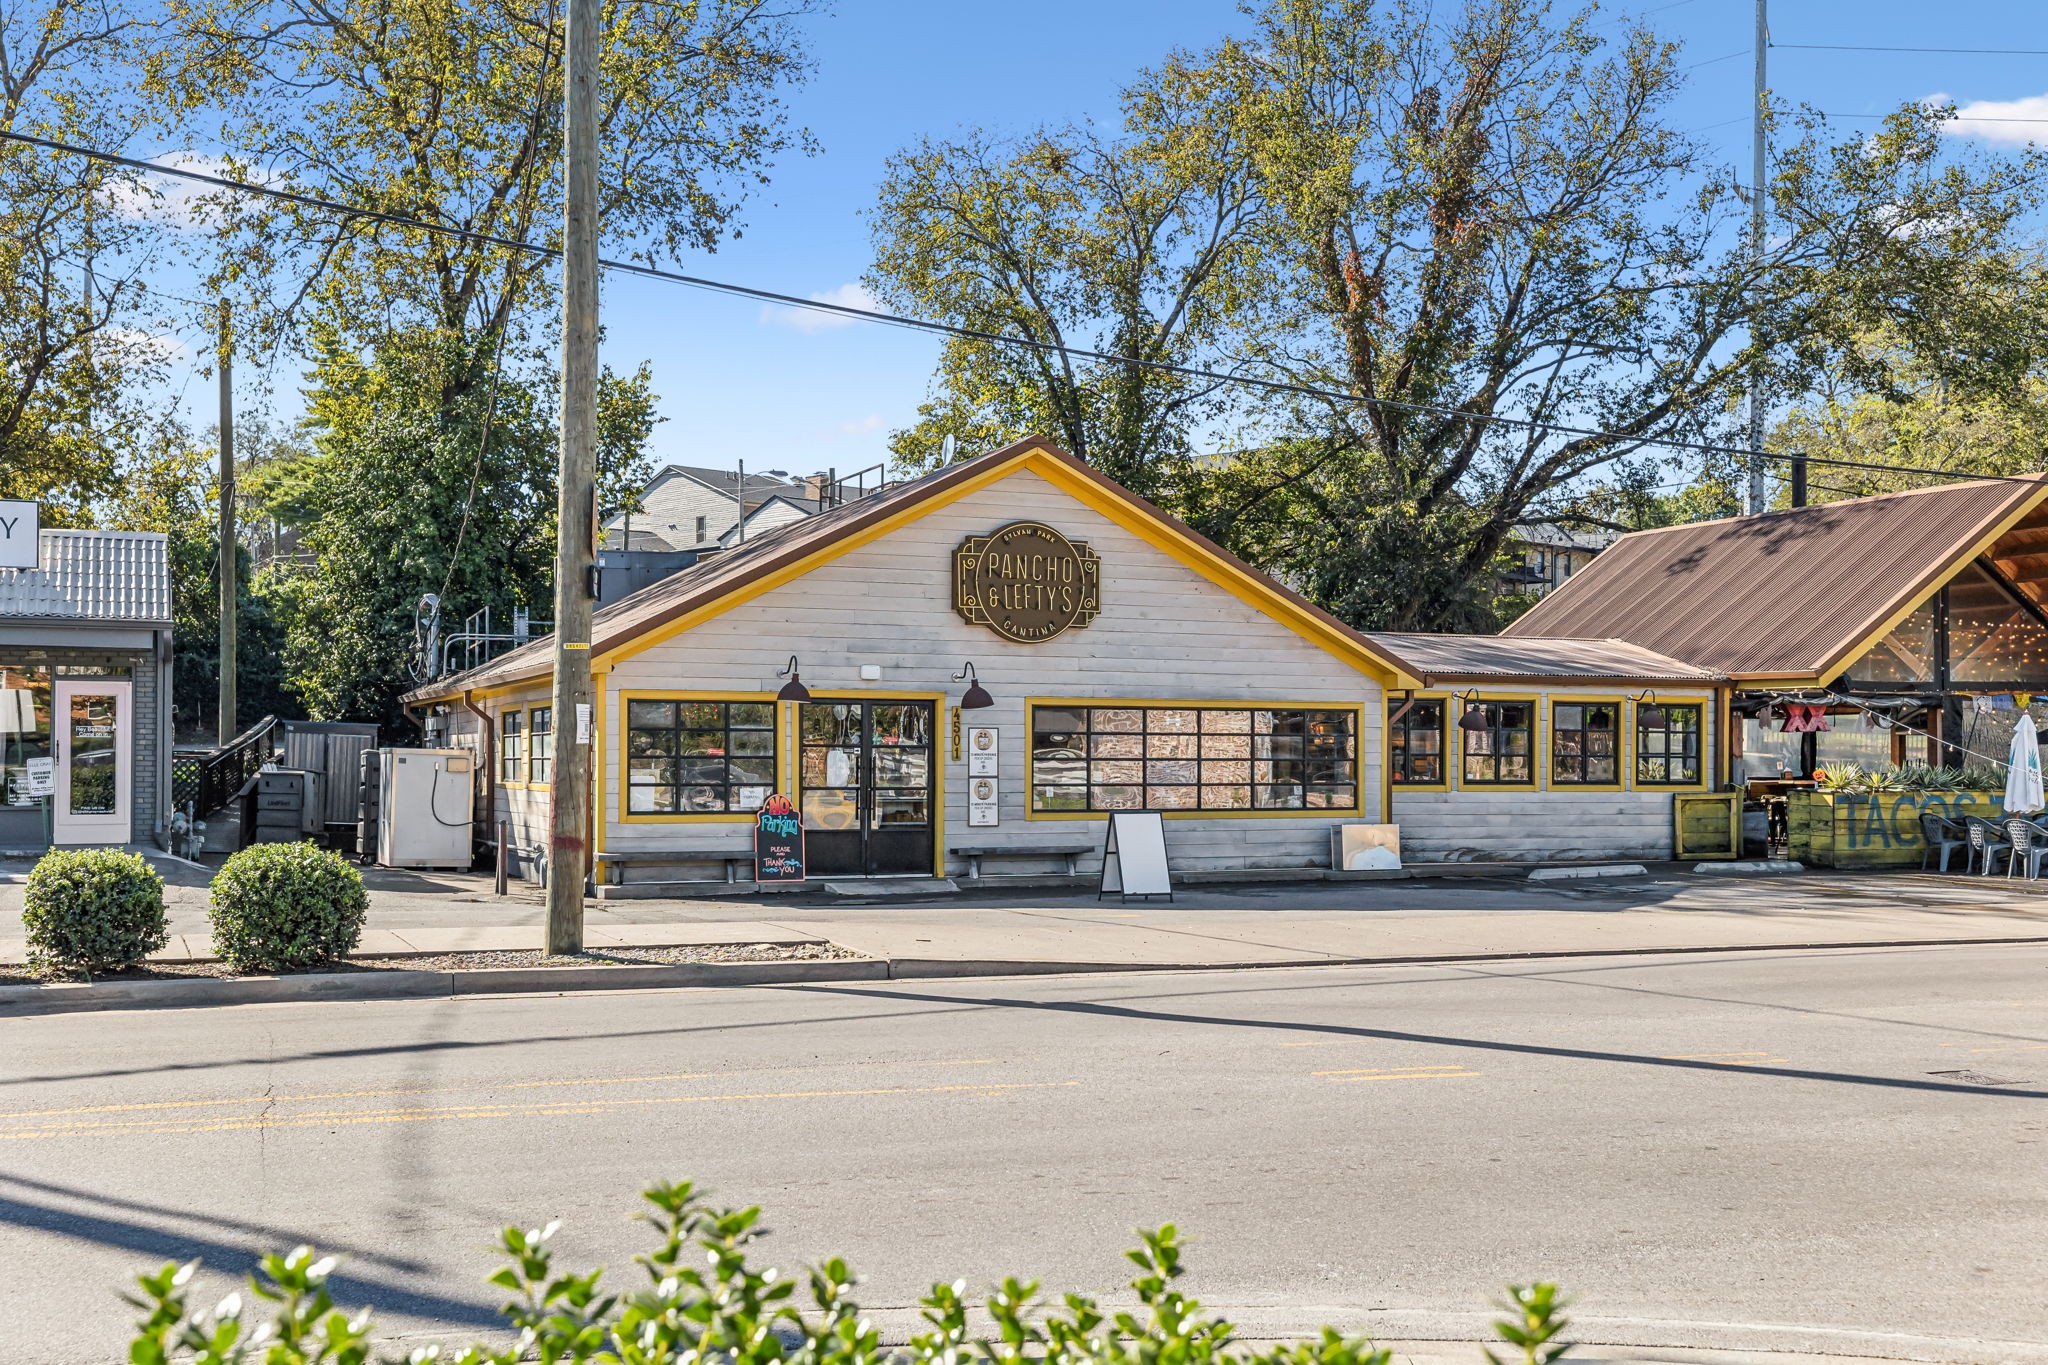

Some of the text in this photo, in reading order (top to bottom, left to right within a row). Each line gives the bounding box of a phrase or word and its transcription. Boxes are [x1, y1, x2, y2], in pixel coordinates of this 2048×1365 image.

[1003, 529, 1055, 543] SYLVAN PARK
[988, 552, 1072, 583] PANCHO
[989, 583, 1072, 612] & LEFTY'S
[1003, 619, 1056, 637] CANTINA
[953, 707, 961, 760] 4501
[769, 795, 790, 815] NO
[761, 814, 798, 838] Parking
[763, 857, 786, 867] THANK
[780, 866, 795, 877] YOU
